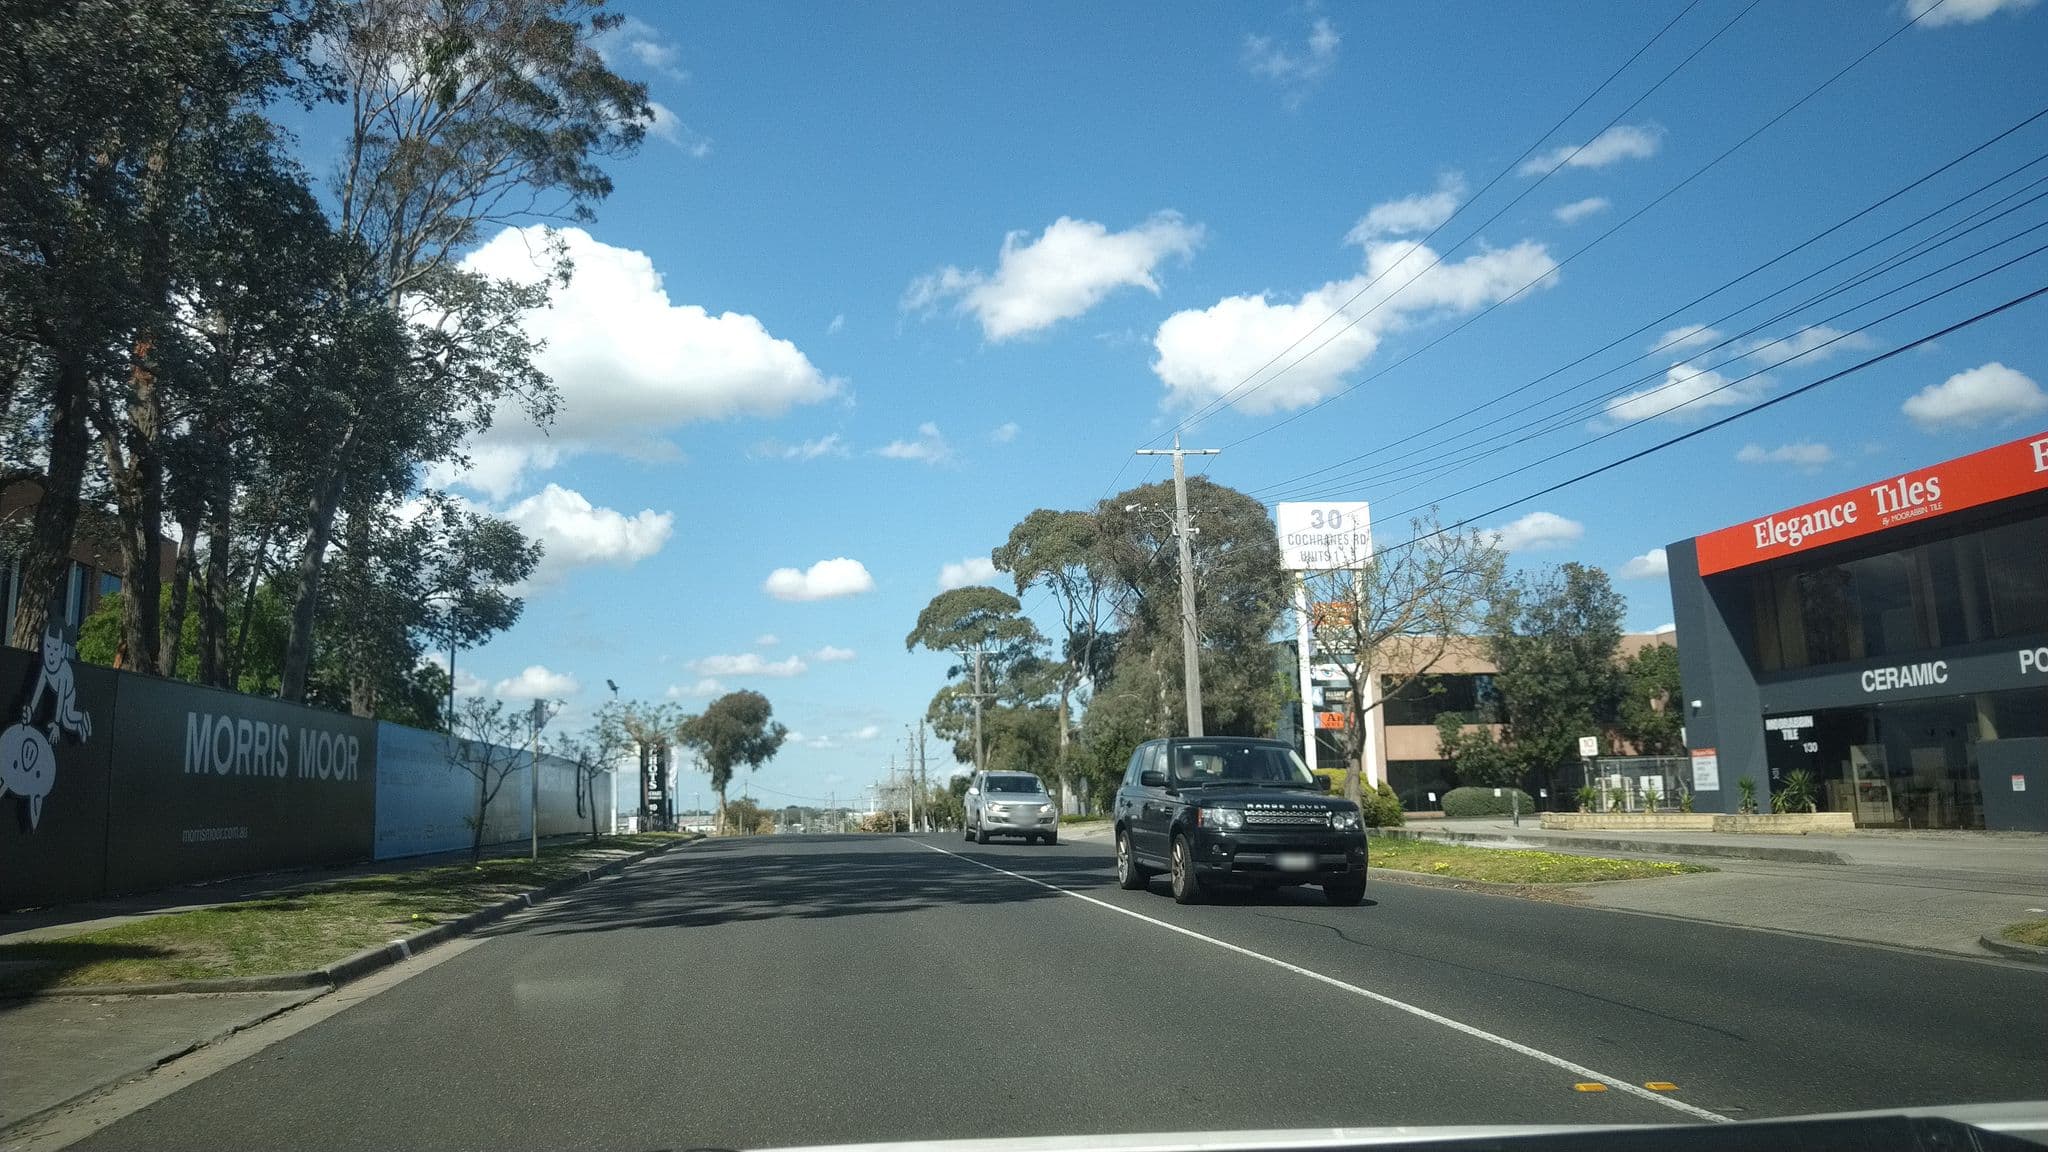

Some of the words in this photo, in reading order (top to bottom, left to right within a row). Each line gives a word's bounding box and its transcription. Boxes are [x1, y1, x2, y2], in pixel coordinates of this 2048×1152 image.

[1311, 509, 1342, 529] 30
[1753, 501, 1857, 548] Elegance
[1871, 476, 1941, 515] Tiles
[1891, 506, 1928, 521] MOORABBIN
[1929, 502, 1943, 511] TILE
[1288, 533, 1349, 545] COCHRANES
[1861, 660, 1948, 692] CERAMIC
[1781, 729, 1799, 741] TILE
[184, 711, 290, 778] MORRIS
[298, 727, 360, 781] MOOR
[1803, 742, 1818, 752] 130
